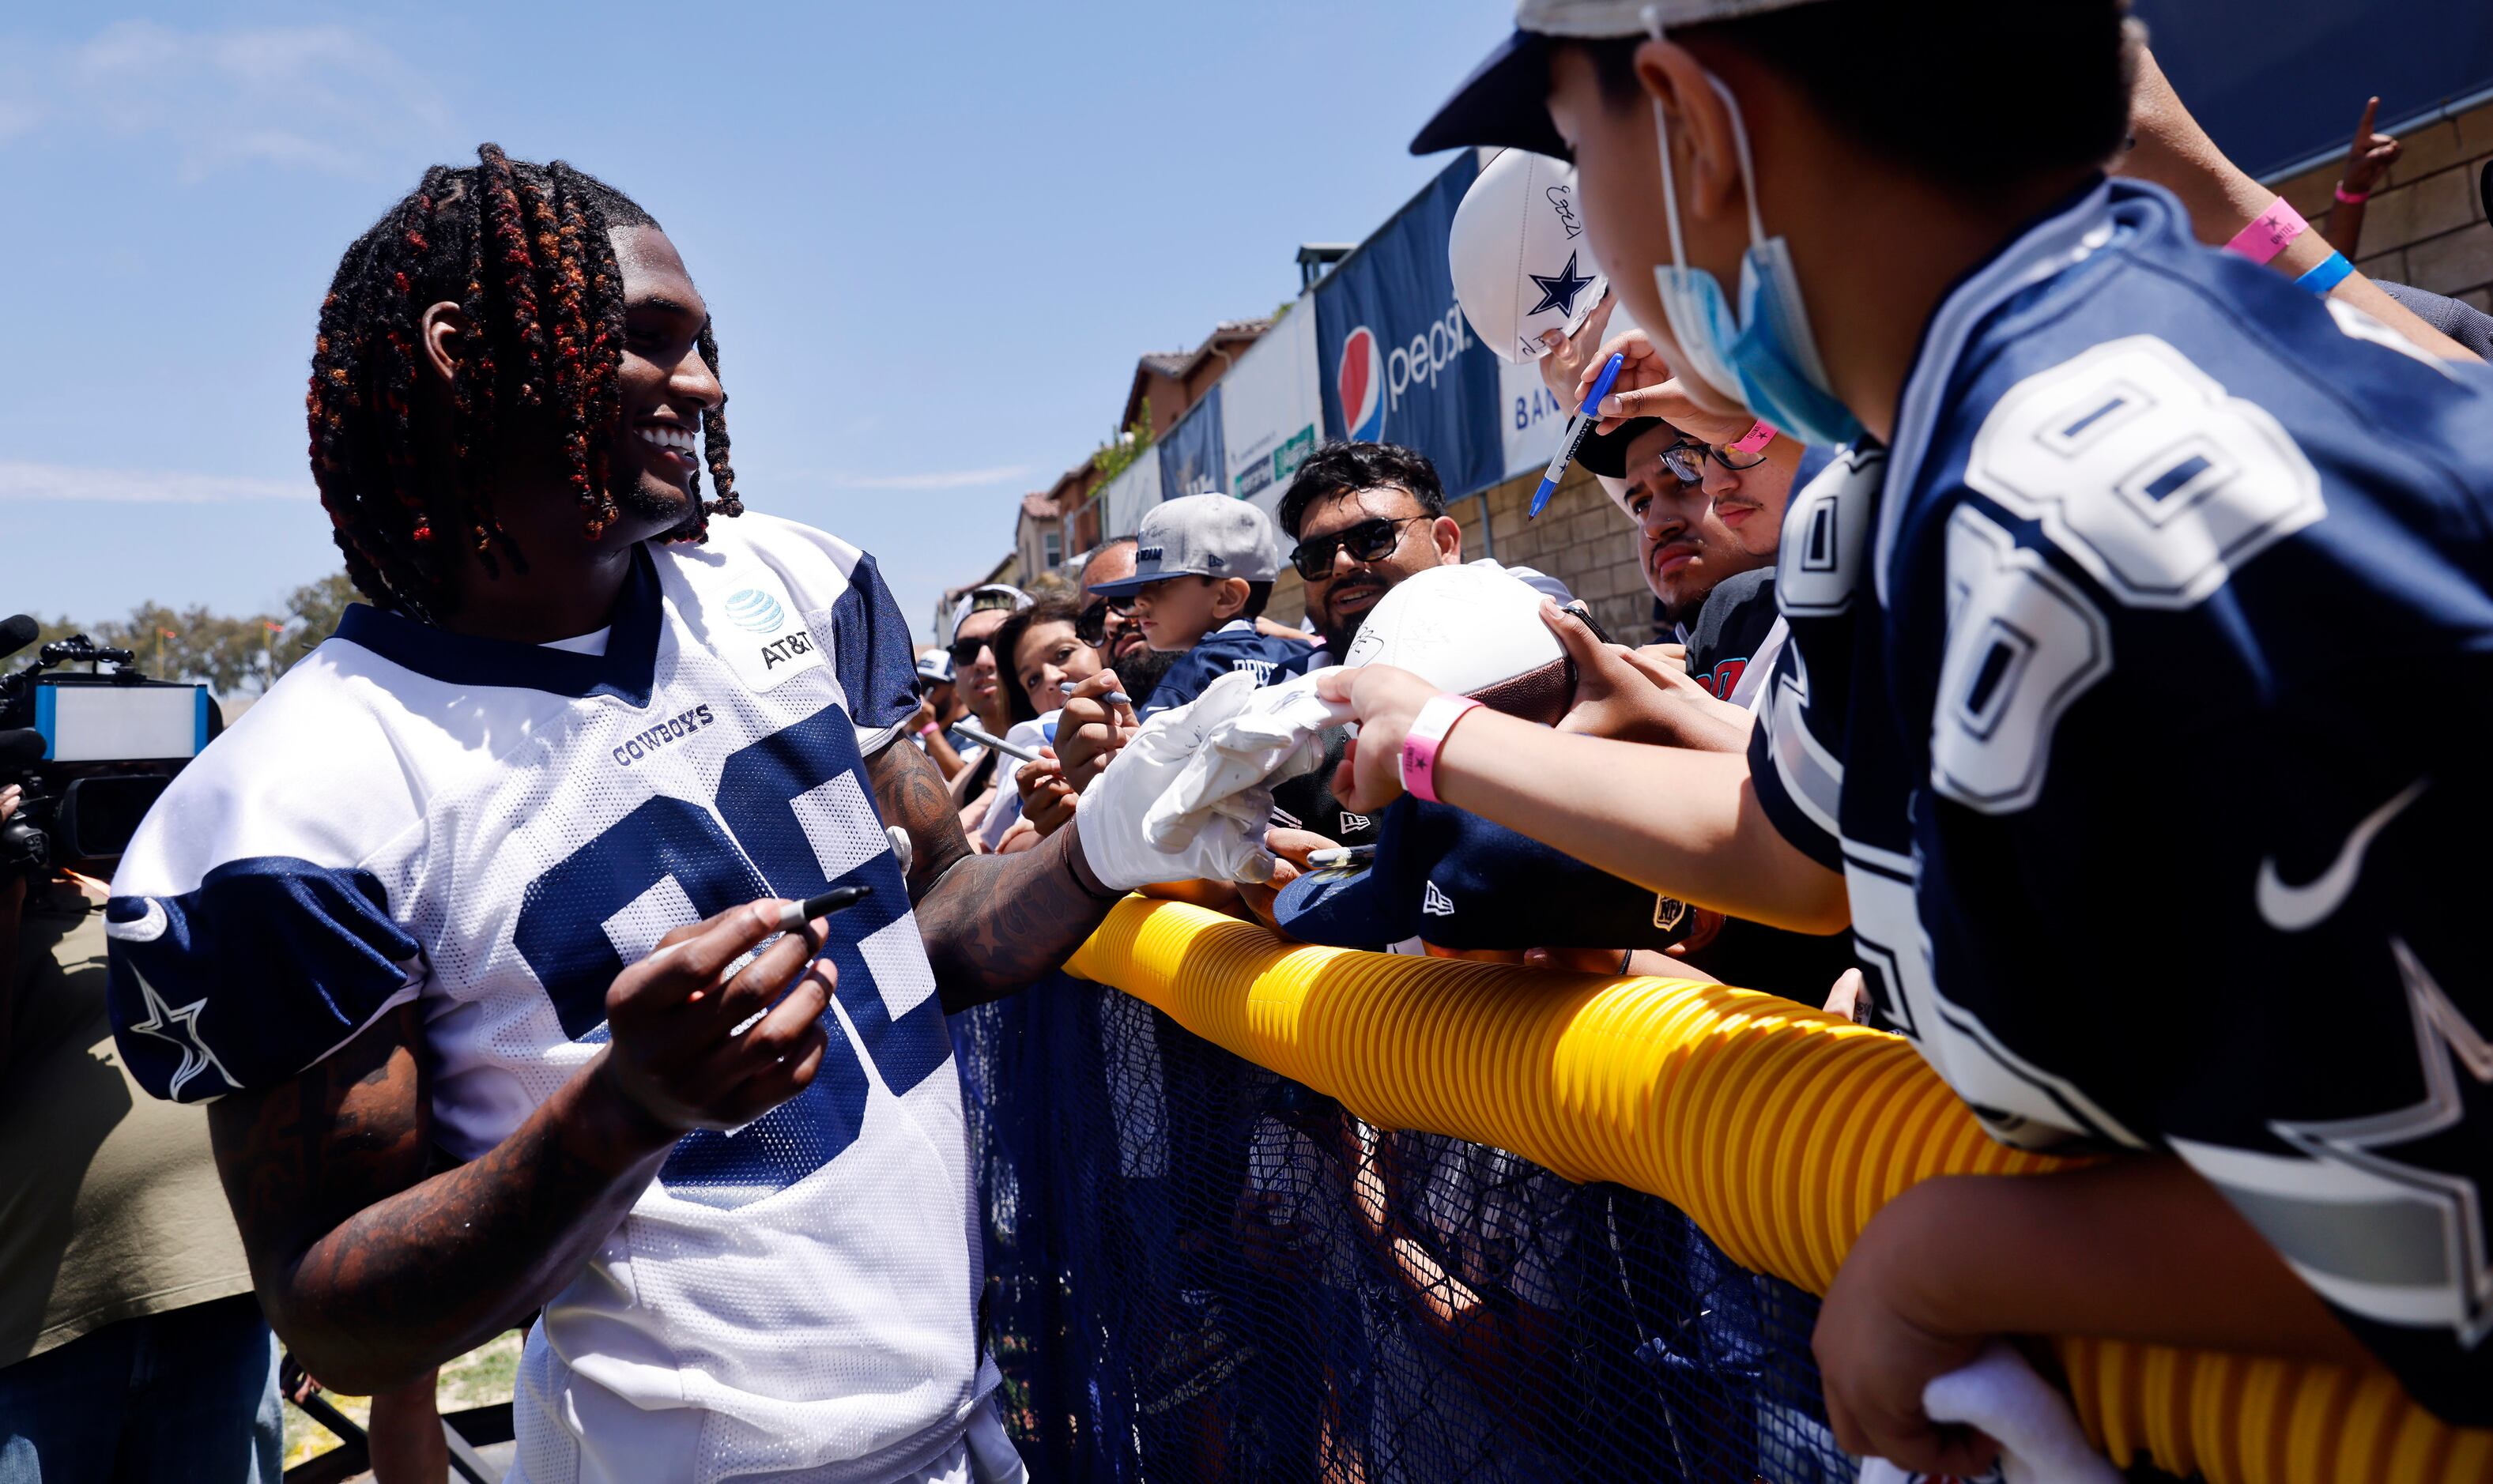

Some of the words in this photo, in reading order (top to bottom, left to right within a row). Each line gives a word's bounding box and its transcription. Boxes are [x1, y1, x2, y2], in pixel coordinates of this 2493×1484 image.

[2270, 223, 2295, 245] UNITED
[1388, 292, 1465, 412] pepsi
[1565, 417, 1593, 461] COWBOYS
[1746, 426, 1762, 439] UNITED
[761, 631, 814, 670] AT&T
[613, 703, 714, 766] COWBOYS
[512, 702, 954, 1211] 88
